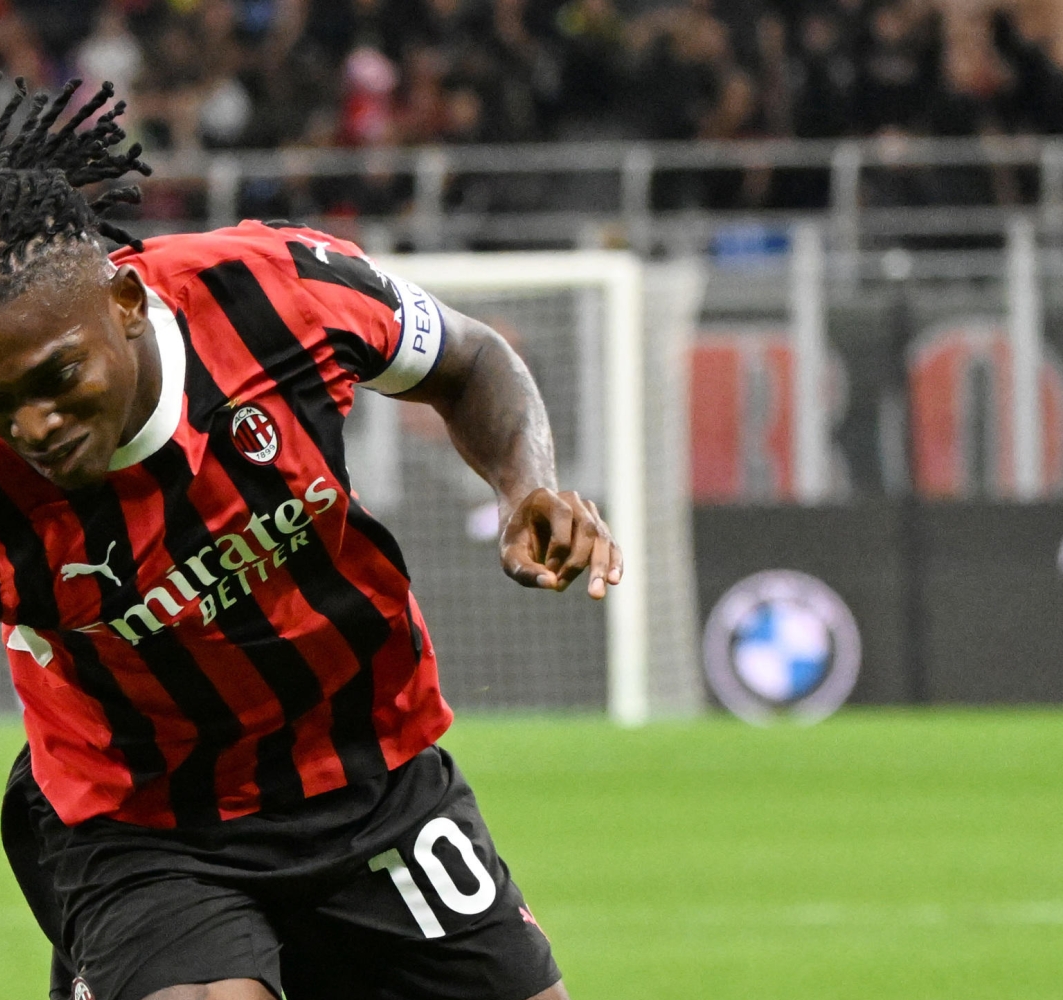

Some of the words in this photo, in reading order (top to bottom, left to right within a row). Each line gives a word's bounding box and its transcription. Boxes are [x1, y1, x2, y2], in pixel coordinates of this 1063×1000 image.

[235, 408, 256, 427] ACM
[256, 444, 276, 460] 1899
[81, 476, 338, 646] mirates
[198, 530, 310, 627] BETTER
[367, 817, 497, 939] 10
